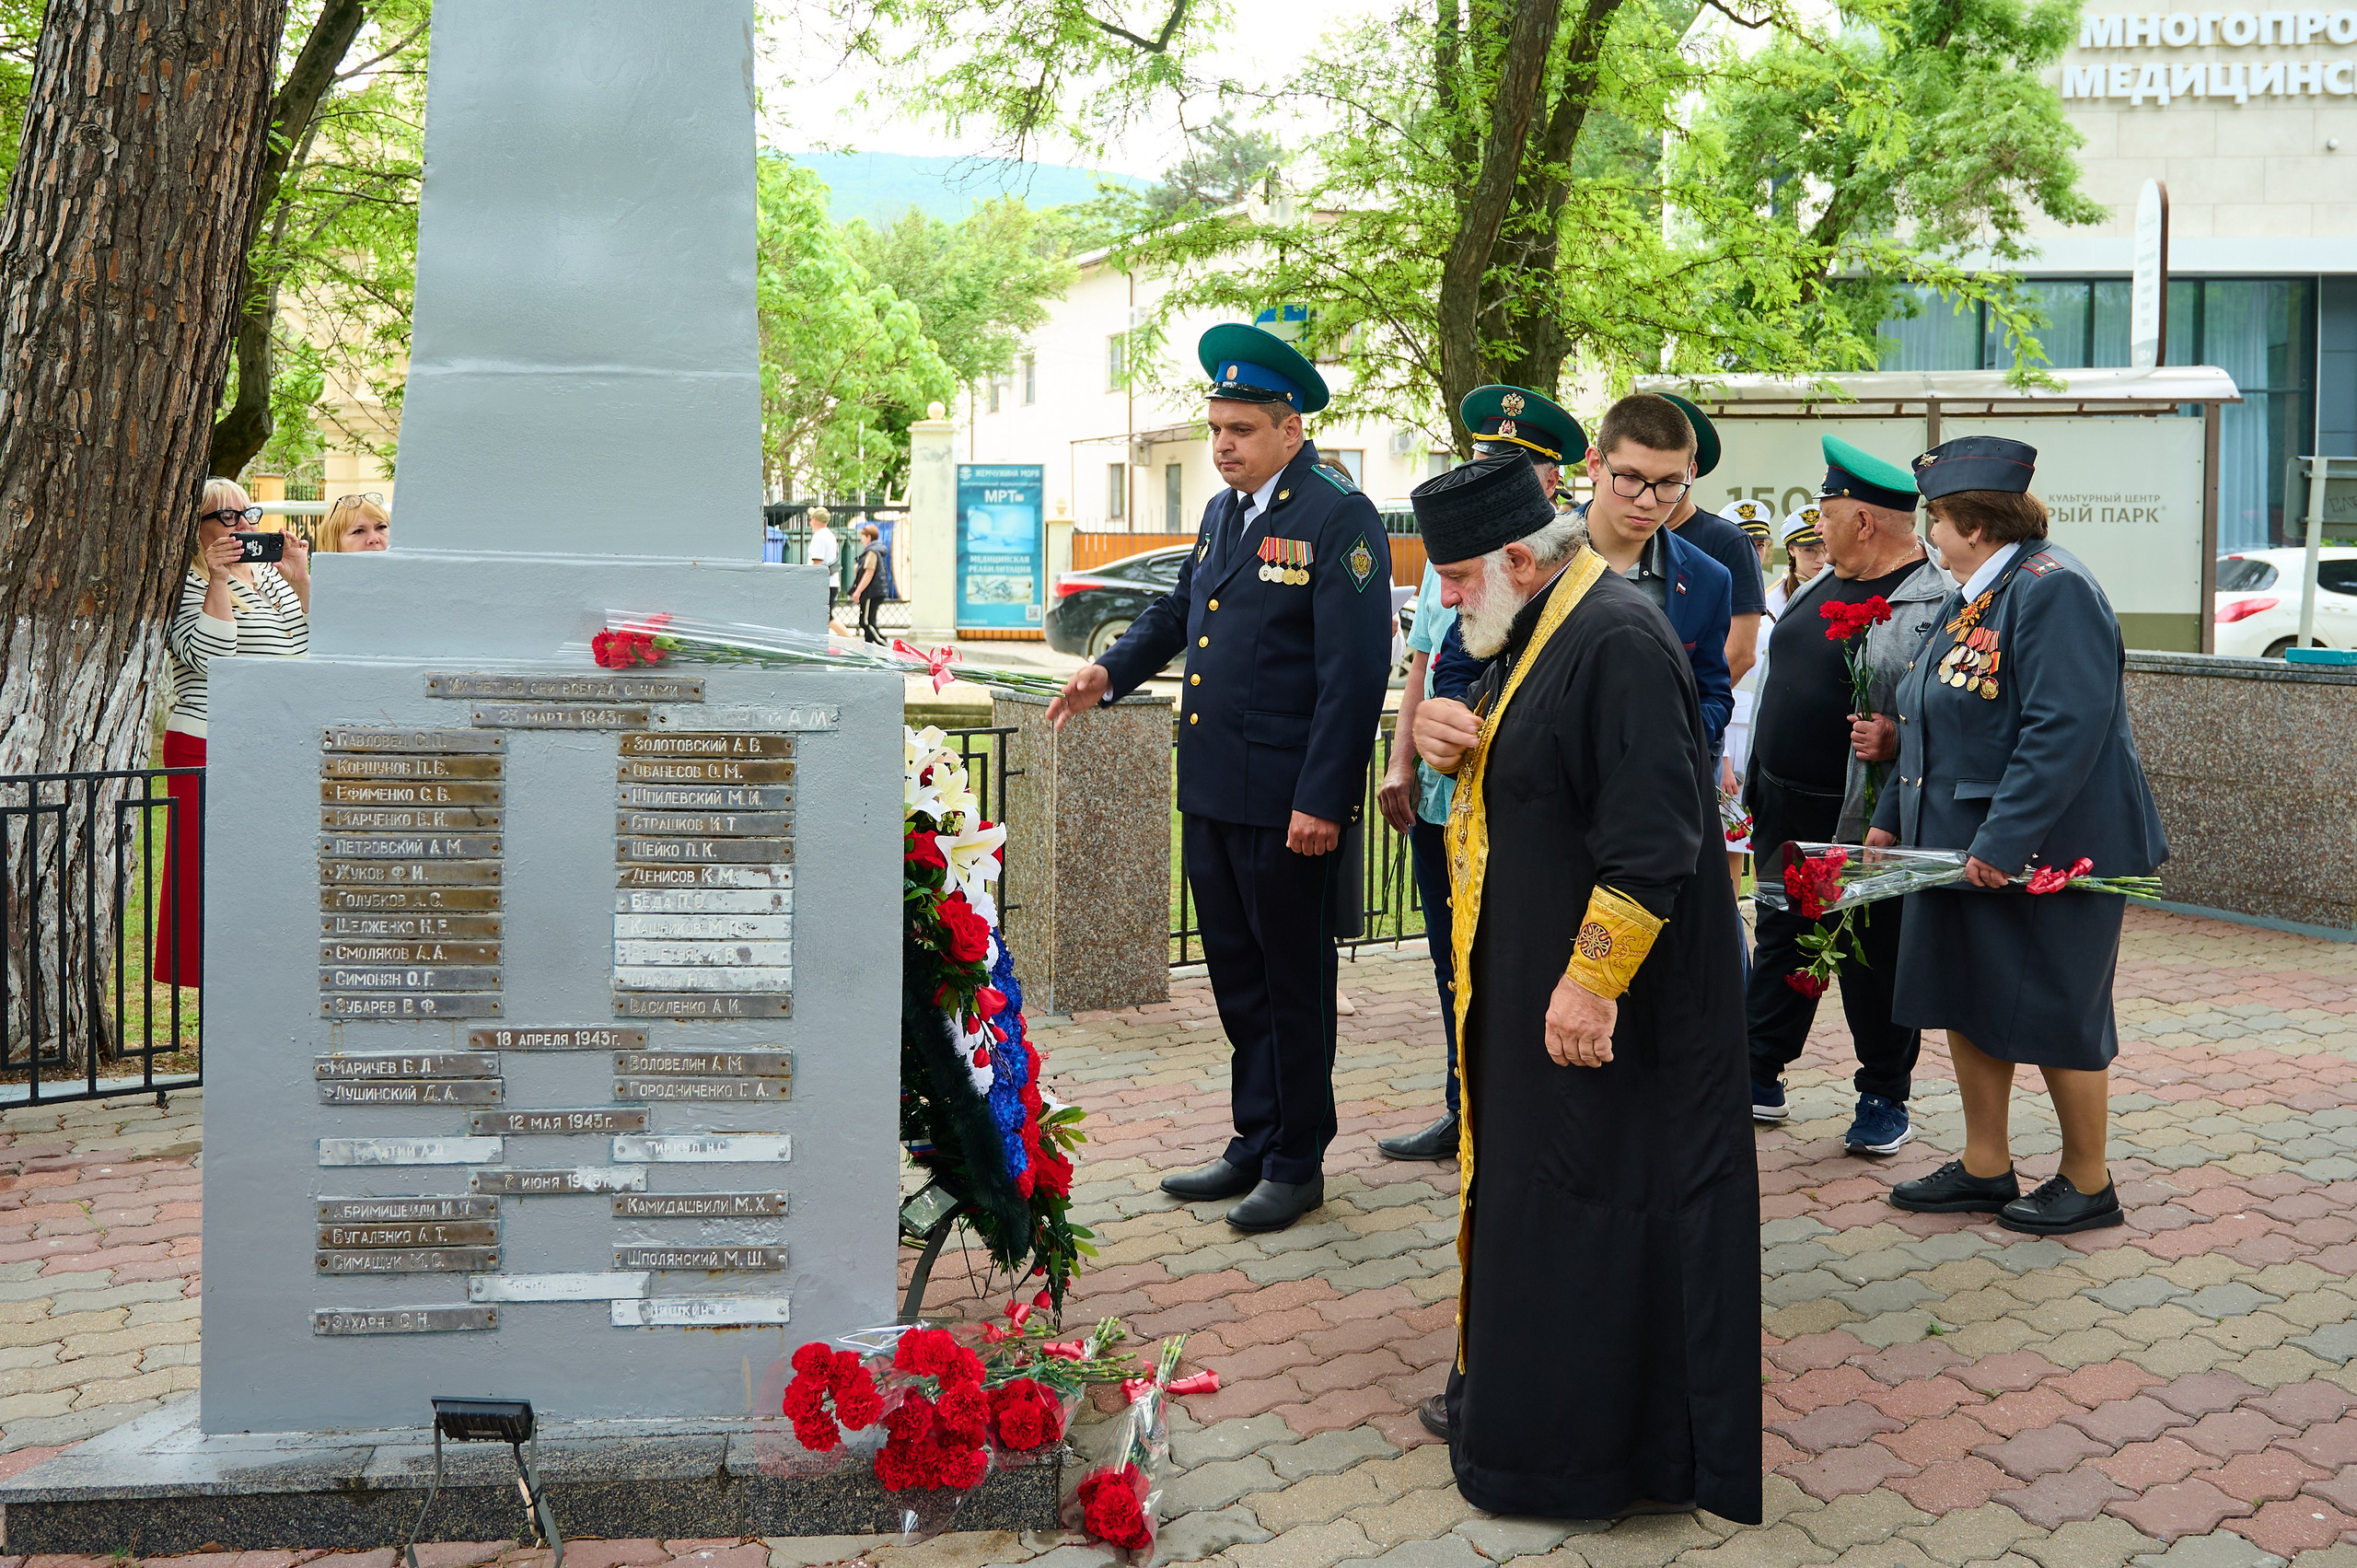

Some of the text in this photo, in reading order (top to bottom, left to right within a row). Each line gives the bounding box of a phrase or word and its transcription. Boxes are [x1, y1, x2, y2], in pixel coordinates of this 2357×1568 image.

[2079, 9, 2357, 48] МНОГОПРО
[2061, 60, 2357, 106] МЕДИЦИНС
[984, 489, 1017, 503] МРТ
[2049, 493, 2161, 504] КУЛЬТУРНЫЙ ЦЕНТР
[970, 555, 1030, 563] МЕДИЦИНСКАЯ
[968, 565, 1031, 574] РЕАБИЛИТАЦИЯ
[563, 683, 615, 697] ВСЕГДА
[624, 684, 633, 696] С
[498, 710, 519, 725] 23
[526, 713, 575, 725] МАРТА
[495, 1031, 512, 1046] 18
[518, 1034, 569, 1046] АПРЕЛЯ
[508, 1115, 525, 1131] 12
[530, 1117, 562, 1131] МАЯ
[505, 1175, 515, 1190] 7
[521, 1177, 560, 1189] ИЮНЯ
